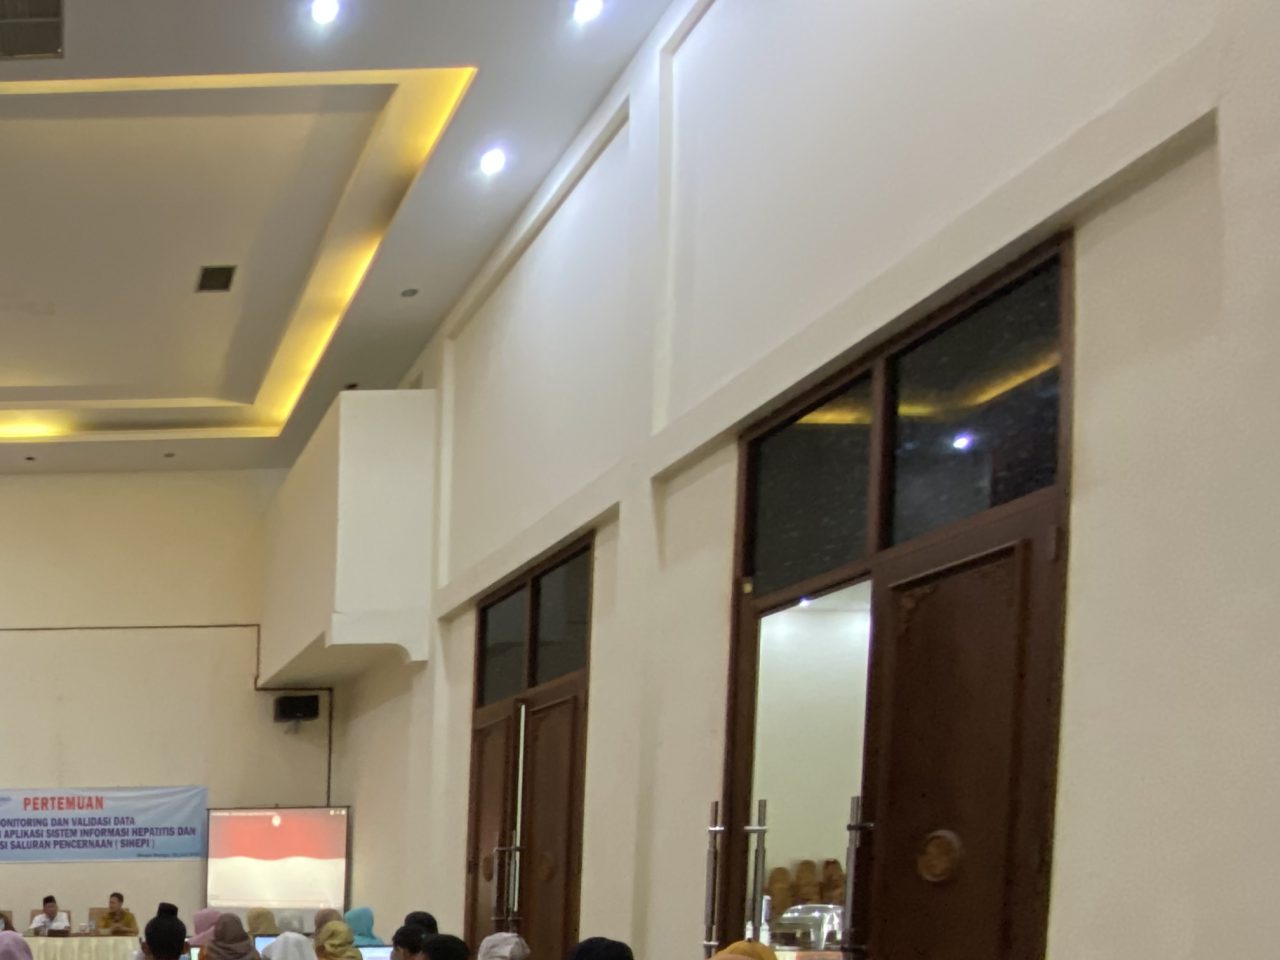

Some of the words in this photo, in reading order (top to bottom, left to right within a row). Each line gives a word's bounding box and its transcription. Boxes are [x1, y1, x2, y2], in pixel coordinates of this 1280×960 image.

[23, 797, 104, 811] PERTEMUAN
[51, 819, 69, 827] DAN
[72, 817, 112, 827] VALIDASI
[114, 817, 135, 826] DATA
[4, 829, 44, 839] APLIKASI
[46, 829, 78, 838] SISTEM
[80, 828, 129, 838] INFORMASI
[132, 827, 175, 837] HEPATITIS
[178, 827, 196, 836] DAN
[10, 840, 51, 850] SALURAN
[54, 840, 113, 849] PENCERNAAN
